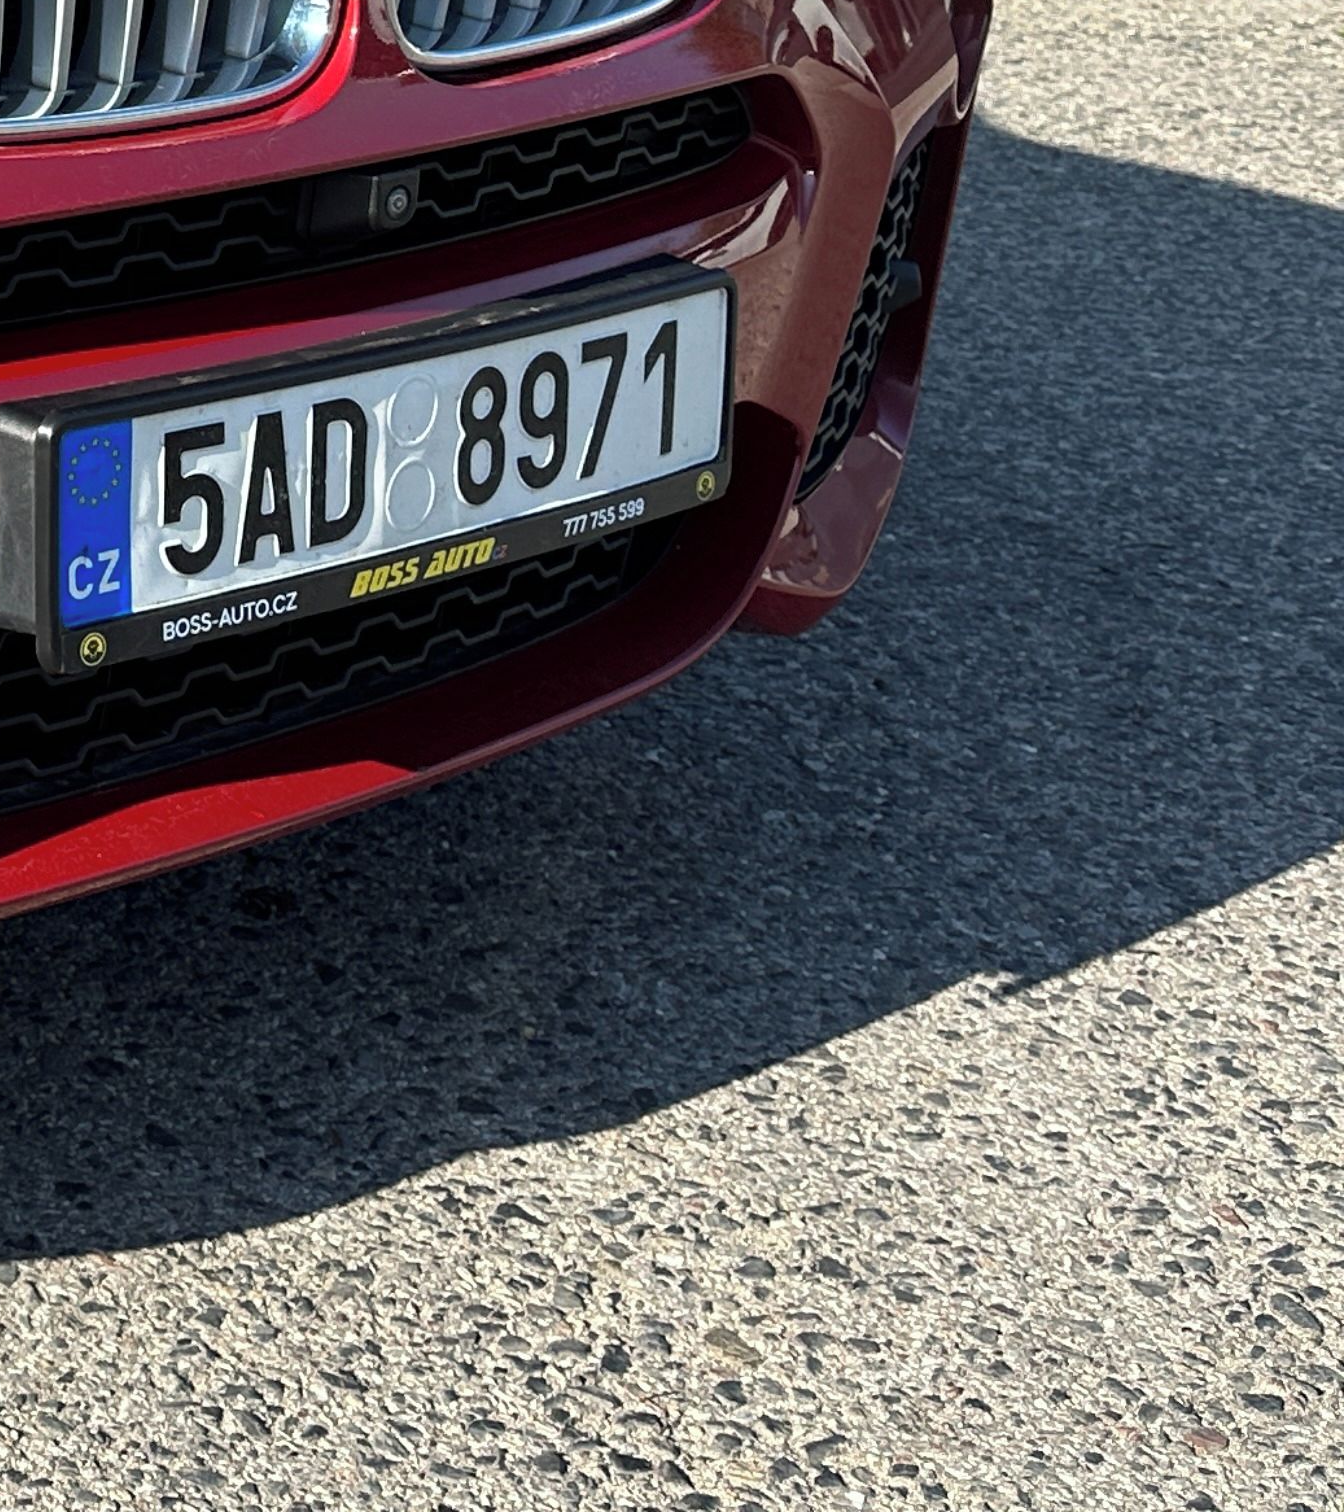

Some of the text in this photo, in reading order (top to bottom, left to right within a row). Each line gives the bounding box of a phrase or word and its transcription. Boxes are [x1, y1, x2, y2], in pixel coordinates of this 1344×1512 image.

[163, 318, 679, 575] 5AD 8971
[562, 497, 646, 538] 777 755 599
[67, 548, 121, 600] CZ
[349, 555, 421, 599] BOSS
[422, 536, 497, 580] AUTO
[162, 590, 298, 642] BOSS-AUTO.CZ
